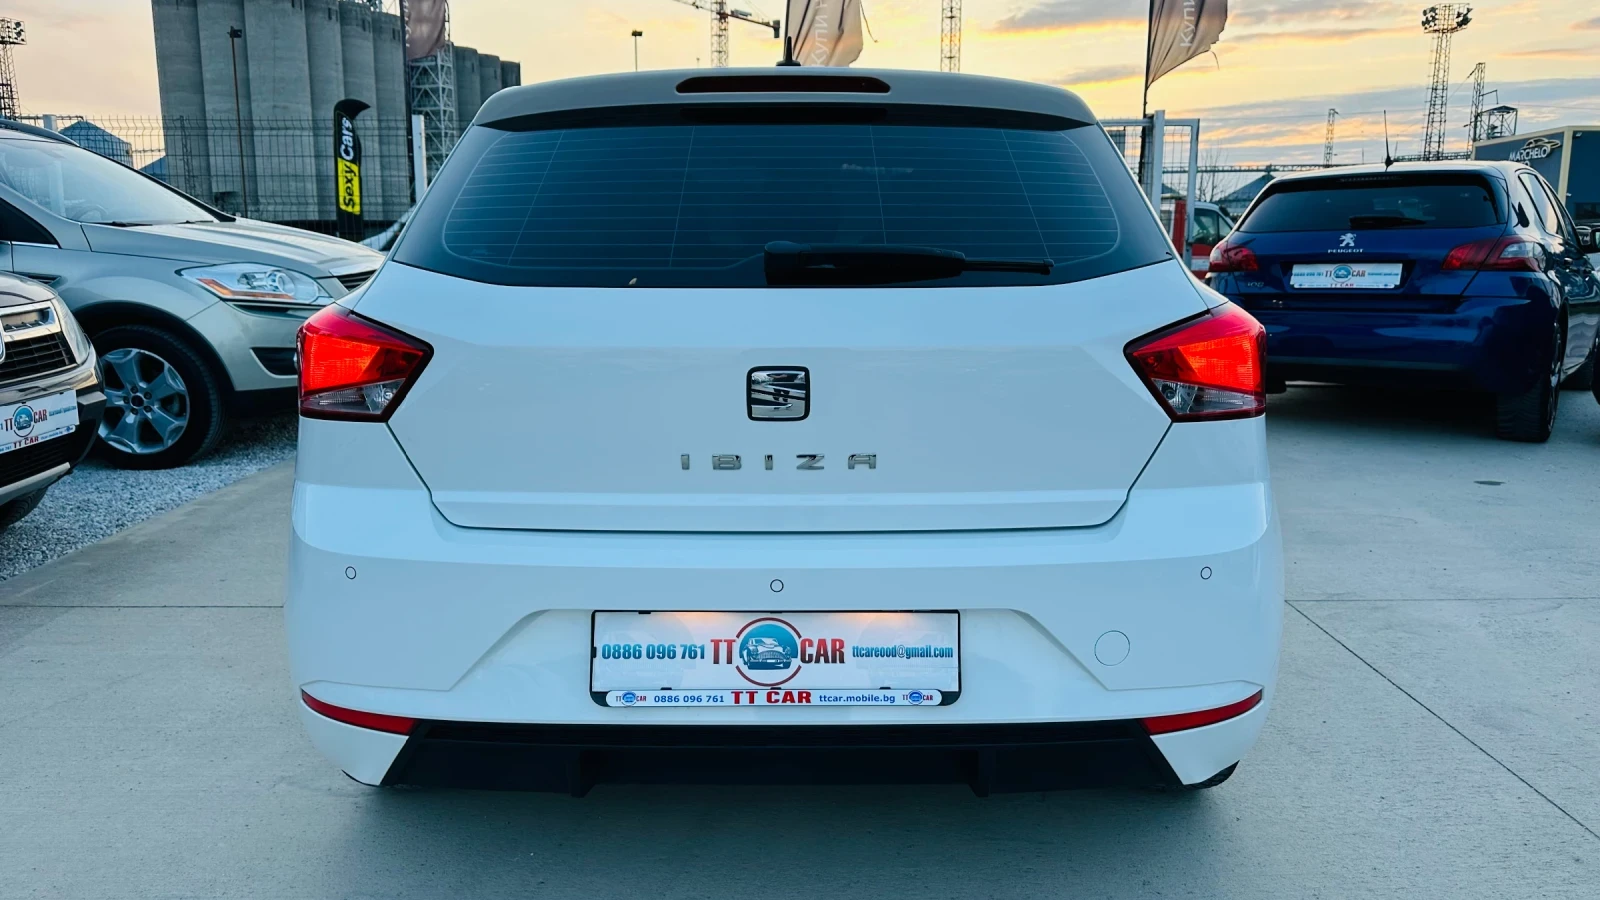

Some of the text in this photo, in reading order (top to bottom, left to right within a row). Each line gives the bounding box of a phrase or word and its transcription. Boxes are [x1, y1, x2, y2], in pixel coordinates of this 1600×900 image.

[1508, 147, 1548, 161] MARCHELO
[339, 117, 357, 209] Sexy Cars
[1351, 270, 1366, 278] CAR
[4, 418, 14, 431] TT
[33, 409, 48, 424] CAR
[13, 440, 22, 448] TT
[24, 436, 39, 445] CAR
[681, 454, 877, 470] IBIZA
[601, 638, 953, 664] 0886 096 761 TT CAR ttcareood@gmail.com
[653, 695, 680, 703] 0886
[683, 695, 703, 703] 096
[706, 695, 724, 703] 761
[731, 690, 758, 705] TT
[766, 690, 812, 704] CAR
[819, 694, 896, 704] ttcar.mobile.bg
